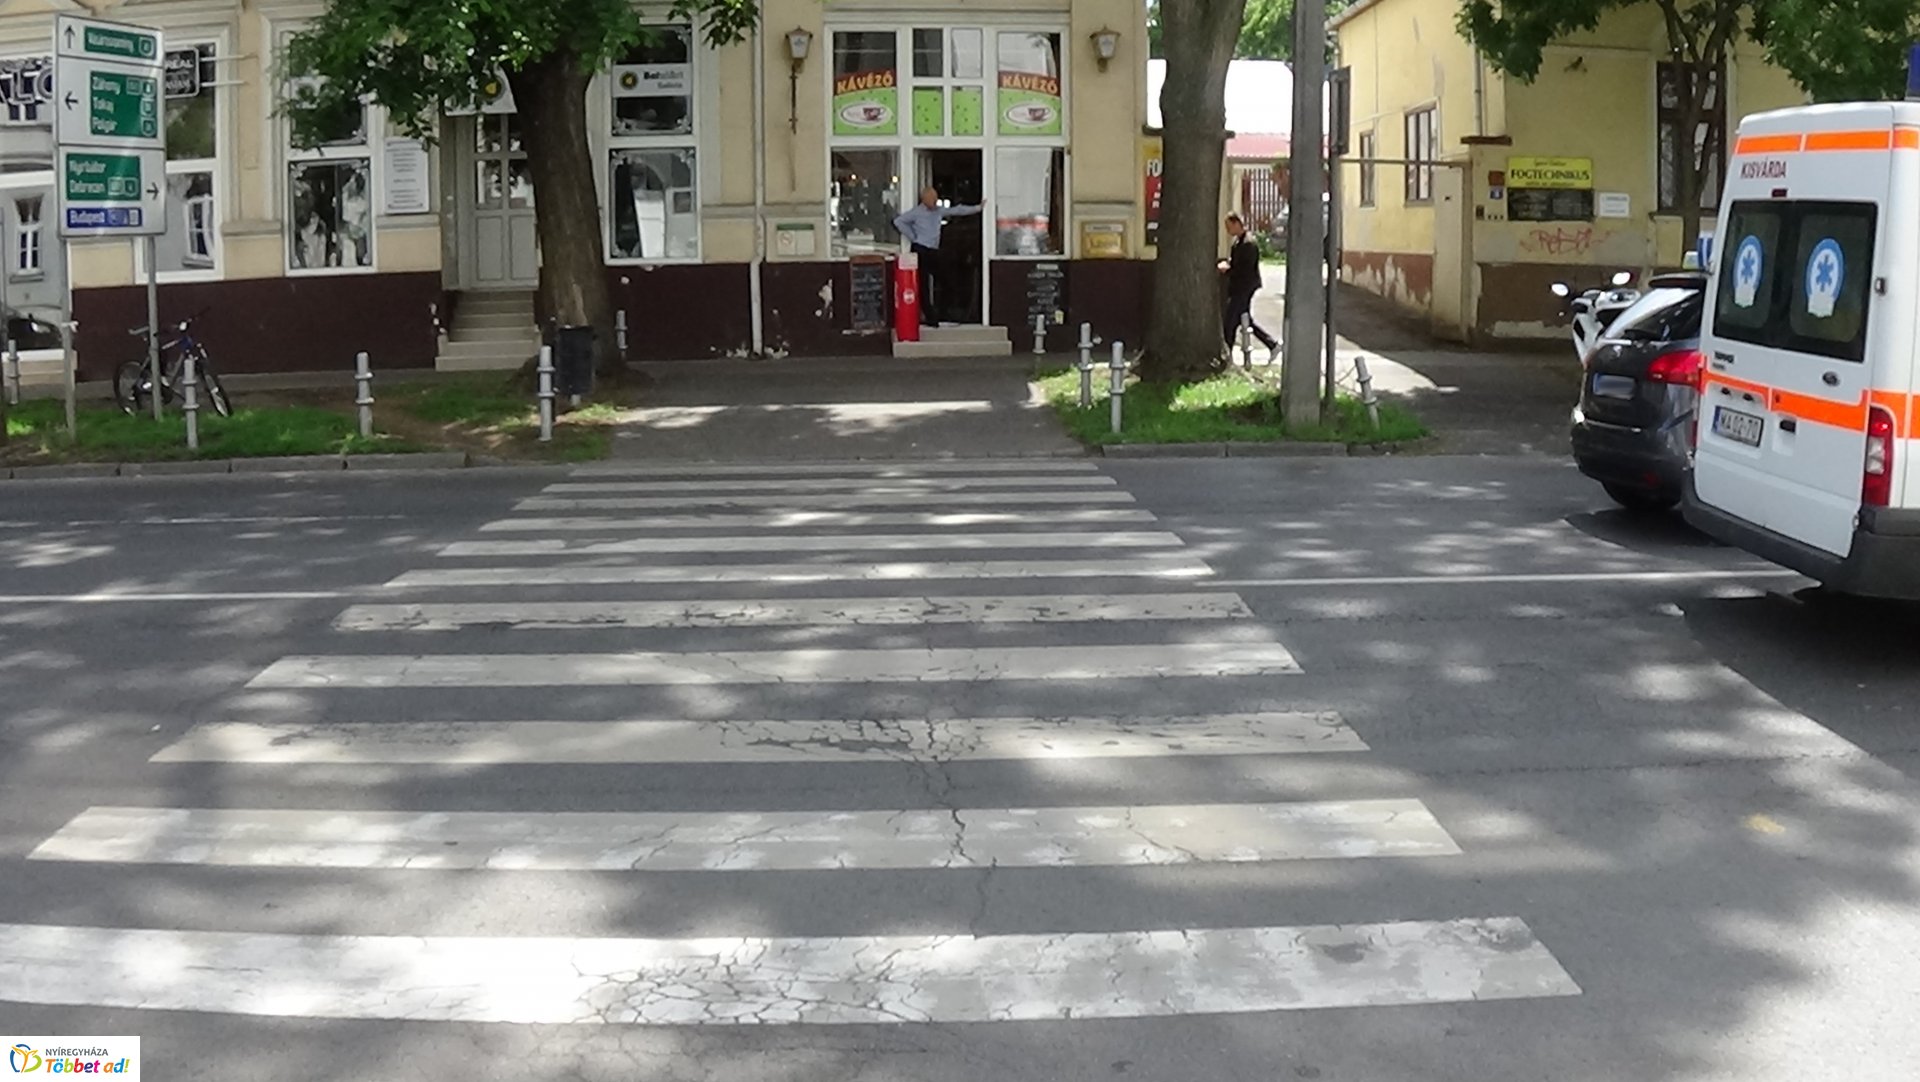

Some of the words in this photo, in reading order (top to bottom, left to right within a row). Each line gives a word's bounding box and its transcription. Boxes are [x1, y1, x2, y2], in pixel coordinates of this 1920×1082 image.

[836, 70, 894, 95] KÁVÉZÓ
[1001, 73, 1059, 95] KÁVÉZÓ
[1510, 168, 1591, 181] FOGTECHNIKUS
[1740, 157, 1788, 179] KISVÁRDA
